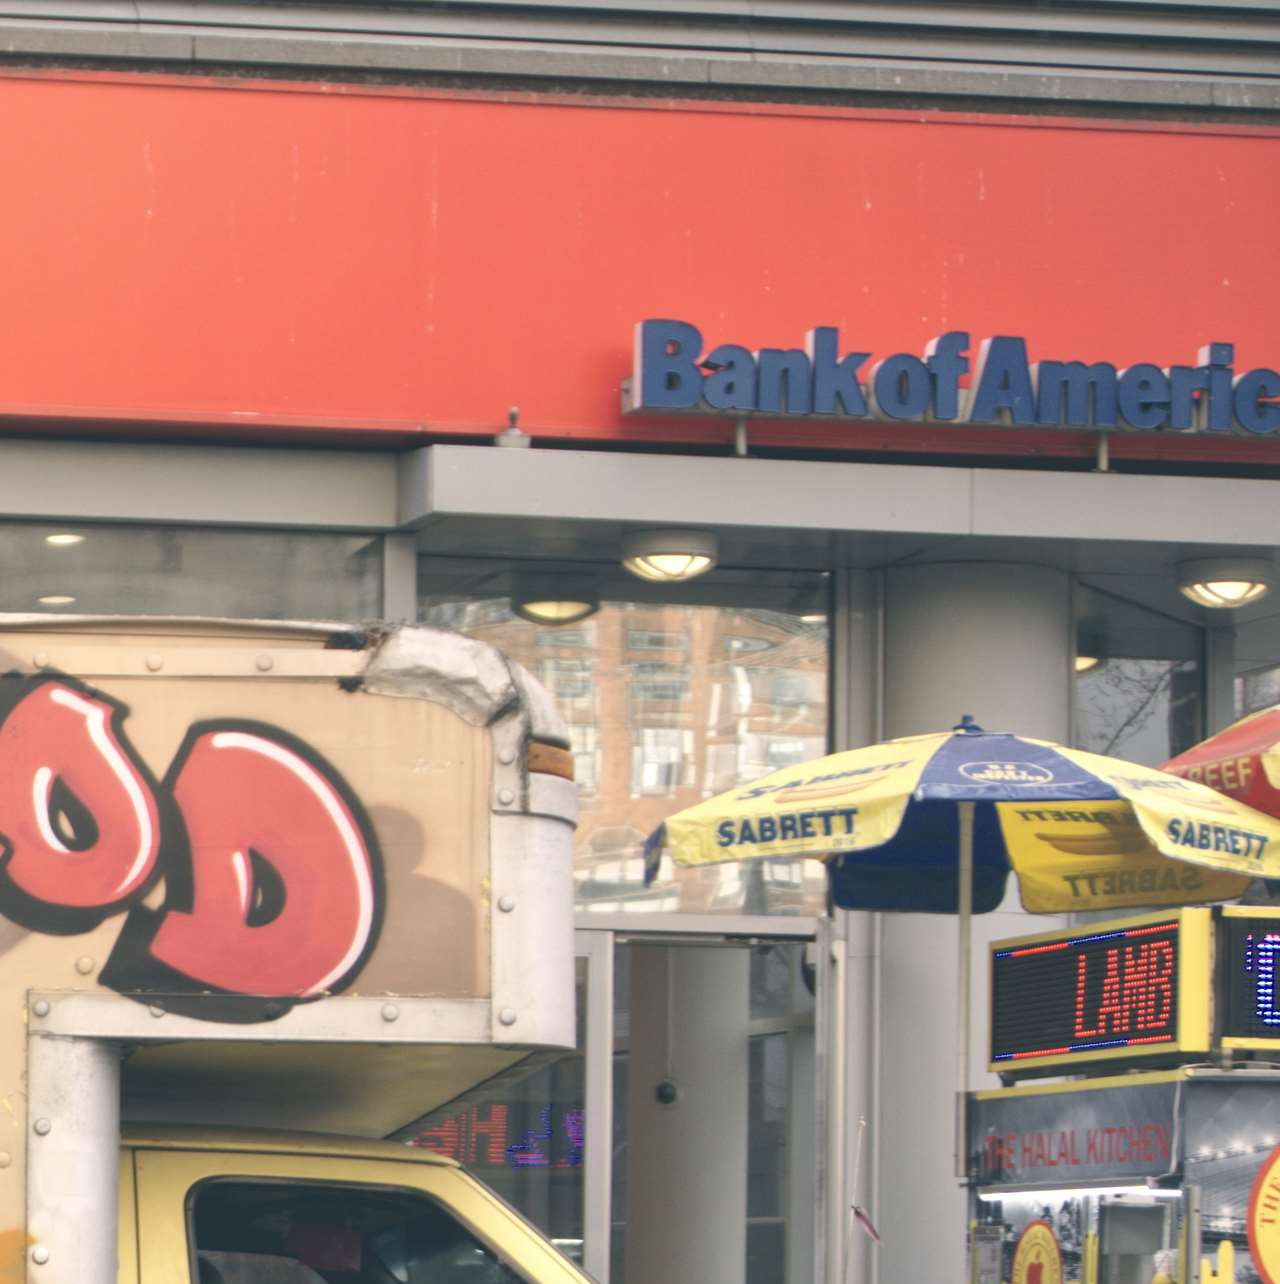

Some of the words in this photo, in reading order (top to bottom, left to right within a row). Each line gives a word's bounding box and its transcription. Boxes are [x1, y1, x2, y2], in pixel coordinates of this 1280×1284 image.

[635, 319, 872, 416] Bank
[872, 332, 970, 422] of
[717, 808, 859, 848] SABRETT
[1167, 818, 1269, 860] SABRETT
[1074, 940, 1173, 1038] LAMB
[984, 1134, 1017, 1170] THE
[1021, 1128, 1081, 1169] HALAL
[1087, 1121, 1171, 1165] KITCHEN
